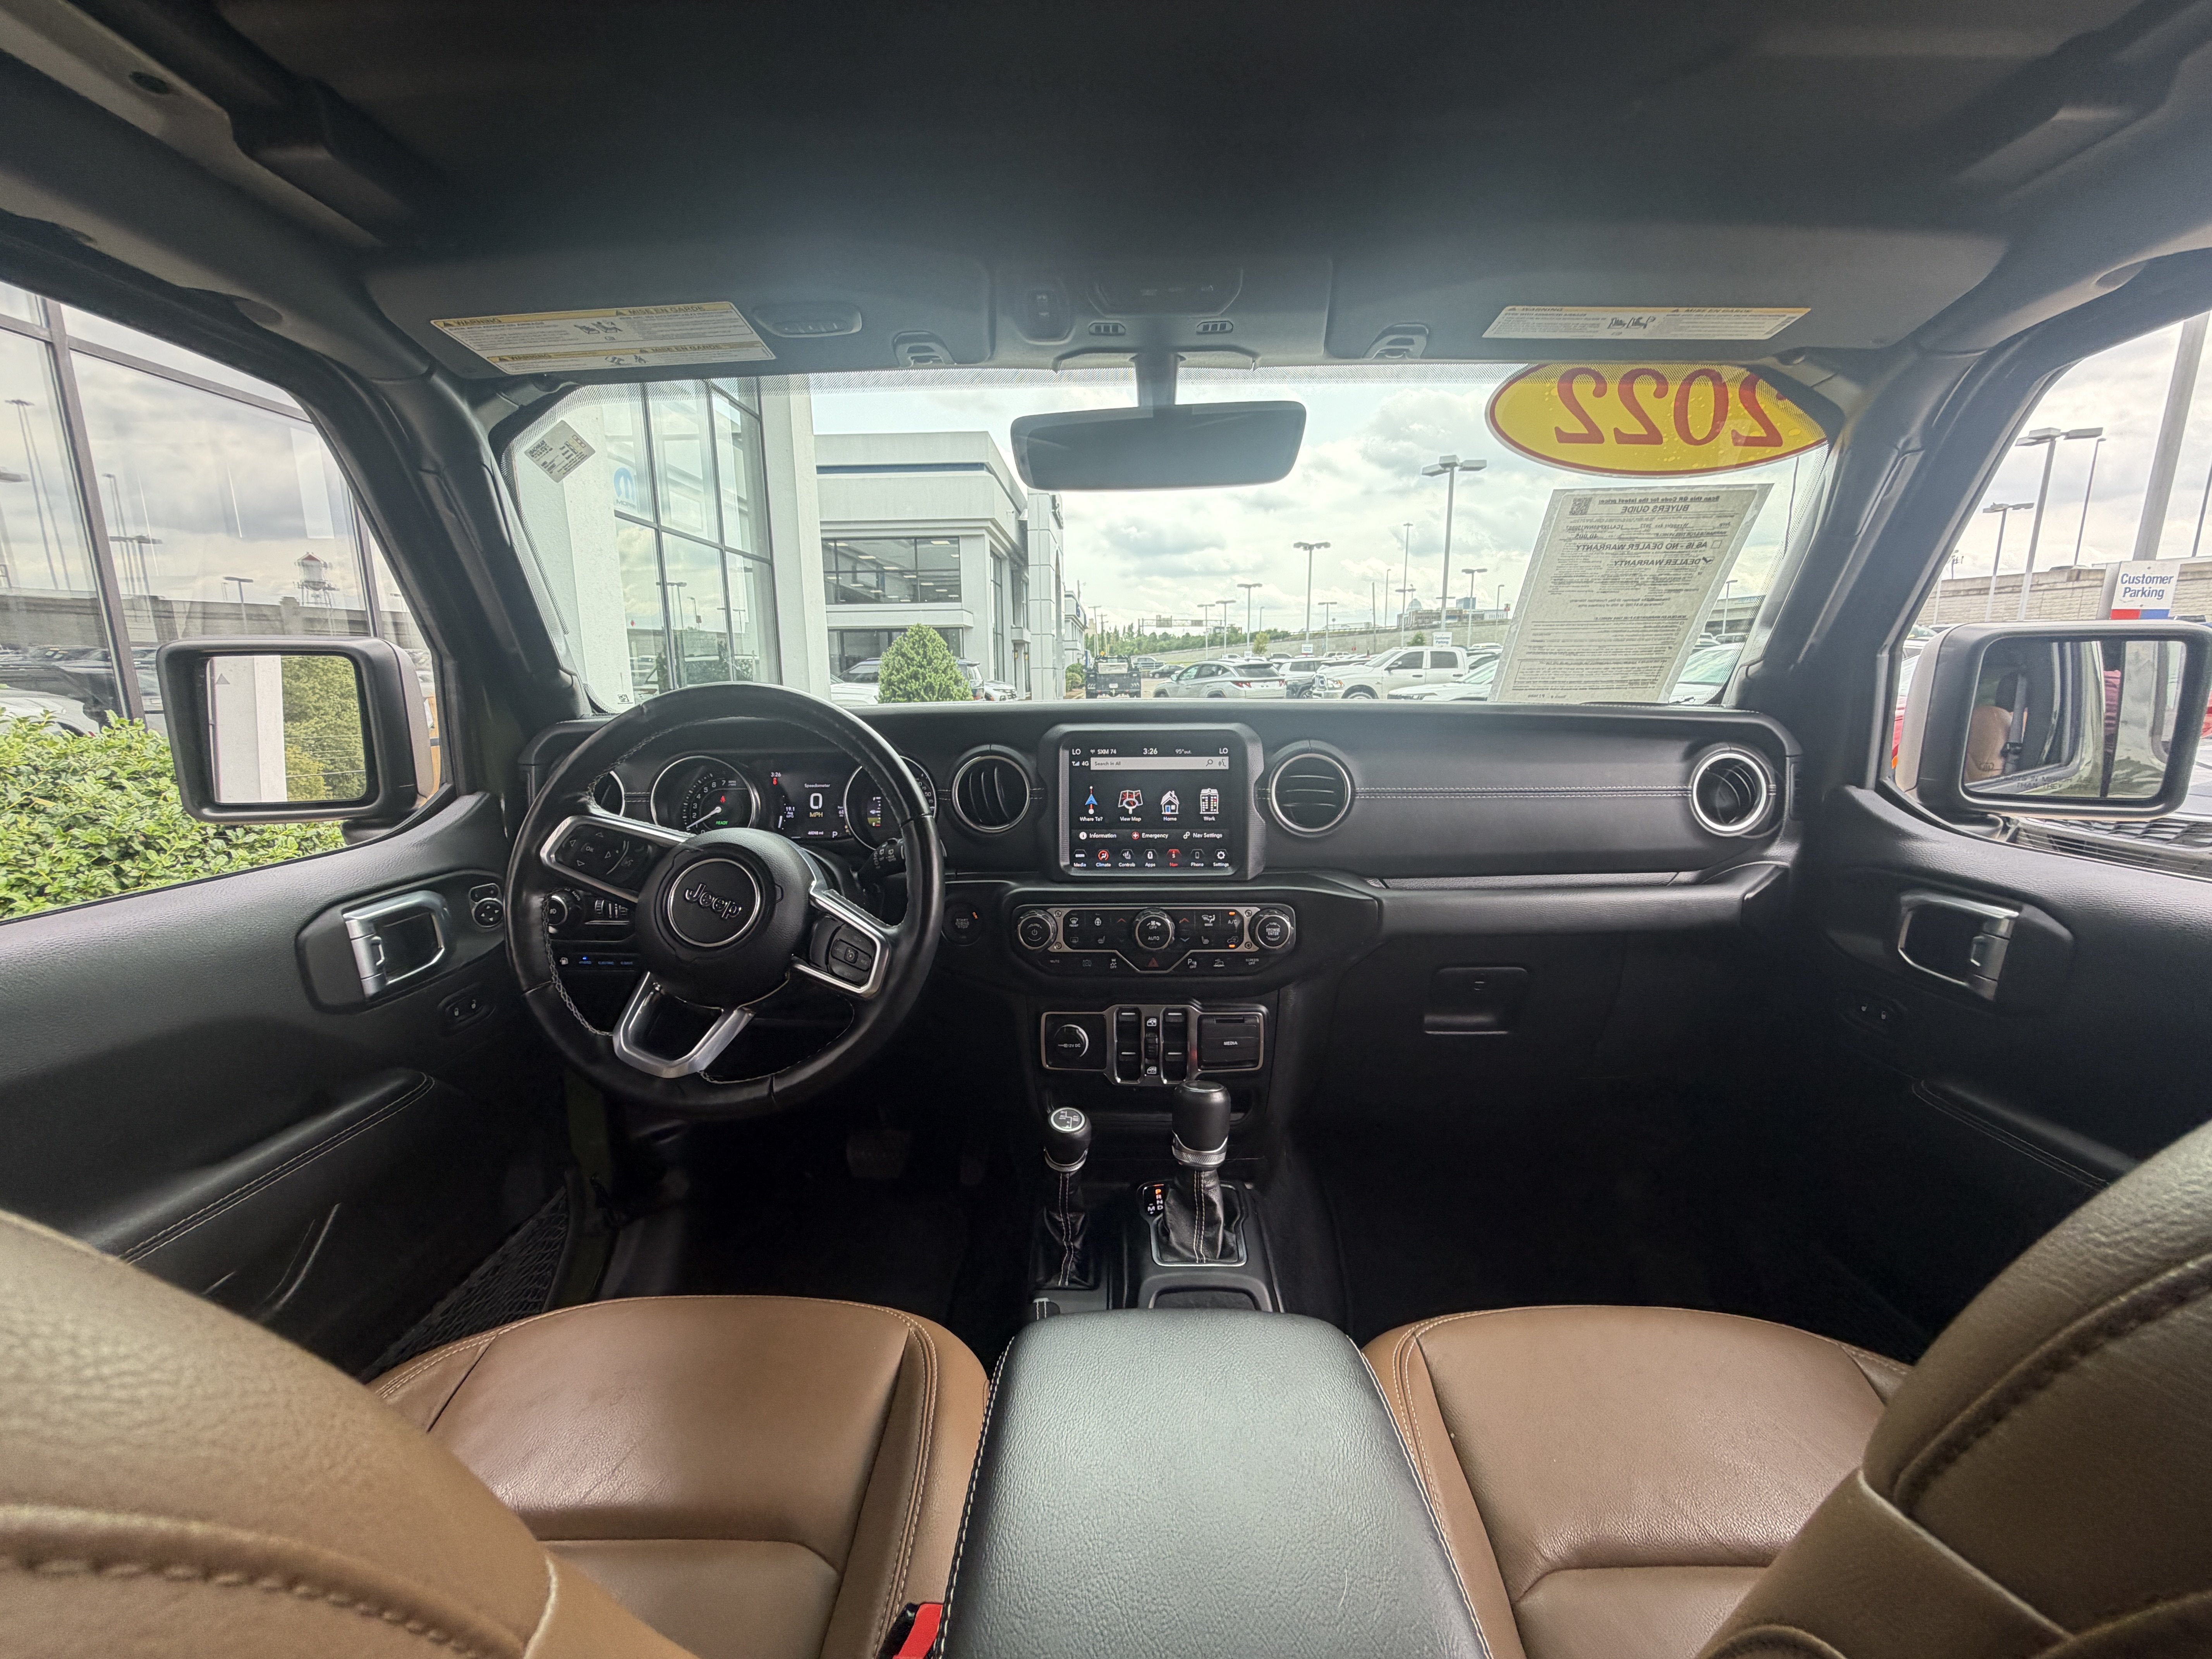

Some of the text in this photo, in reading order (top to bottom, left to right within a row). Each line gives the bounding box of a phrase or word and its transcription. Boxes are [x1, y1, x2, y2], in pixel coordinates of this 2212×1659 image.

[2121, 574, 2174, 584] Customer
[2123, 587, 2164, 600] Parking
[810, 793, 823, 809] 0
[684, 883, 742, 919] Jeep
